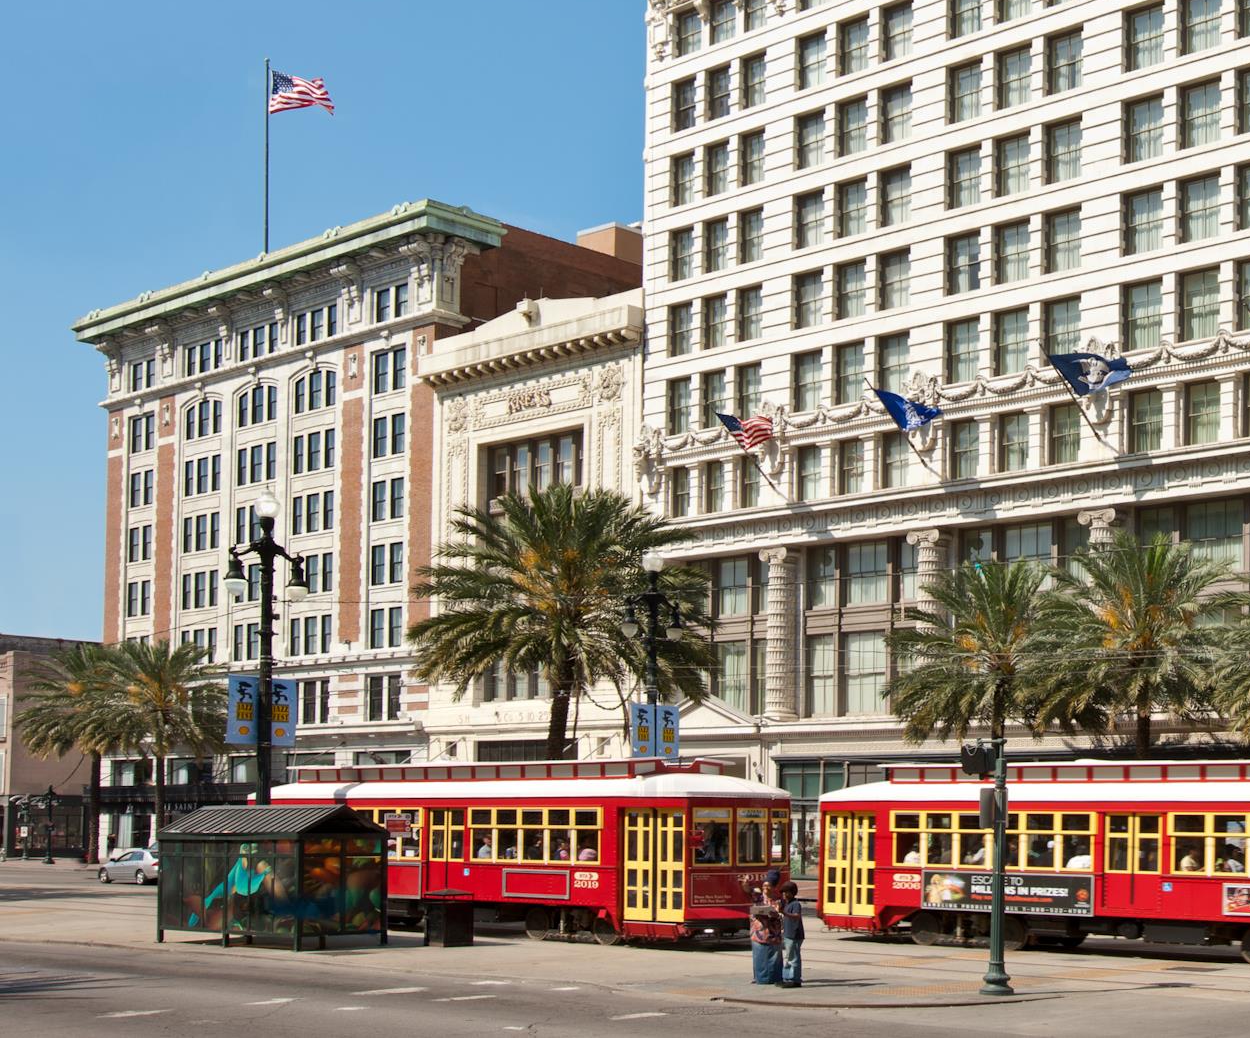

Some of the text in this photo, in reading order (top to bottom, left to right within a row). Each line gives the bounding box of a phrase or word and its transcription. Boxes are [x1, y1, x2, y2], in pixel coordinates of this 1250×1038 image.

[506, 390, 552, 415] KRESS
[174, 803, 198, 811] SAINT
[892, 882, 921, 890] 2006
[1010, 877, 1024, 886] TO
[1017, 886, 1029, 895] IN
[1030, 887, 1069, 897] PRIZES!
